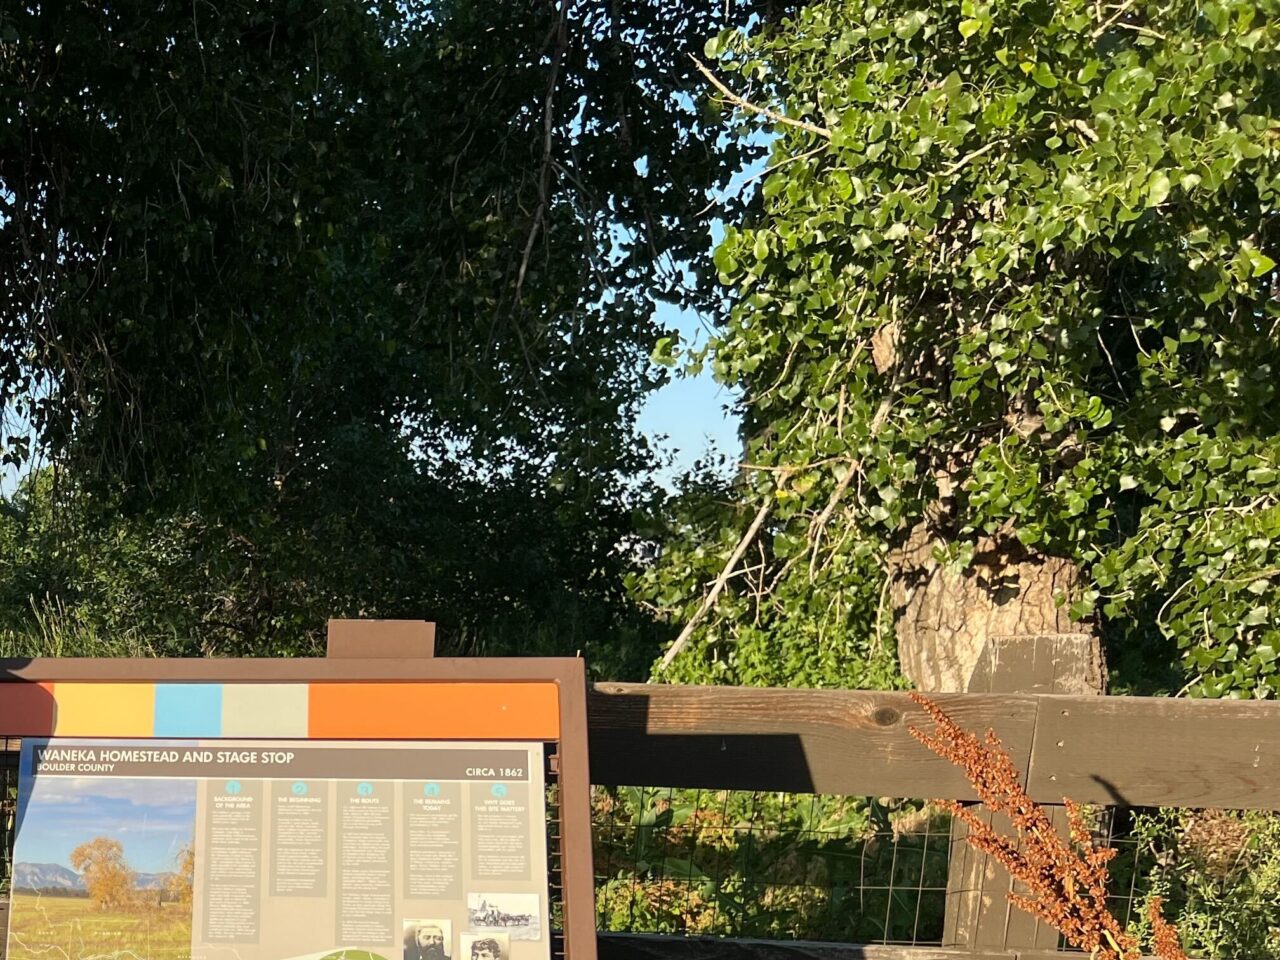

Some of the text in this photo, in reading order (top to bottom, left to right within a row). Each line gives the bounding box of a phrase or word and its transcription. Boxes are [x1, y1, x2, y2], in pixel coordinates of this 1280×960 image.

[37, 749, 295, 764] WANEKA HOMESTEAD AND STAGE STOP
[37, 763, 115, 772] BOULDER COUNTY
[465, 767, 523, 777] CIRCA 1862
